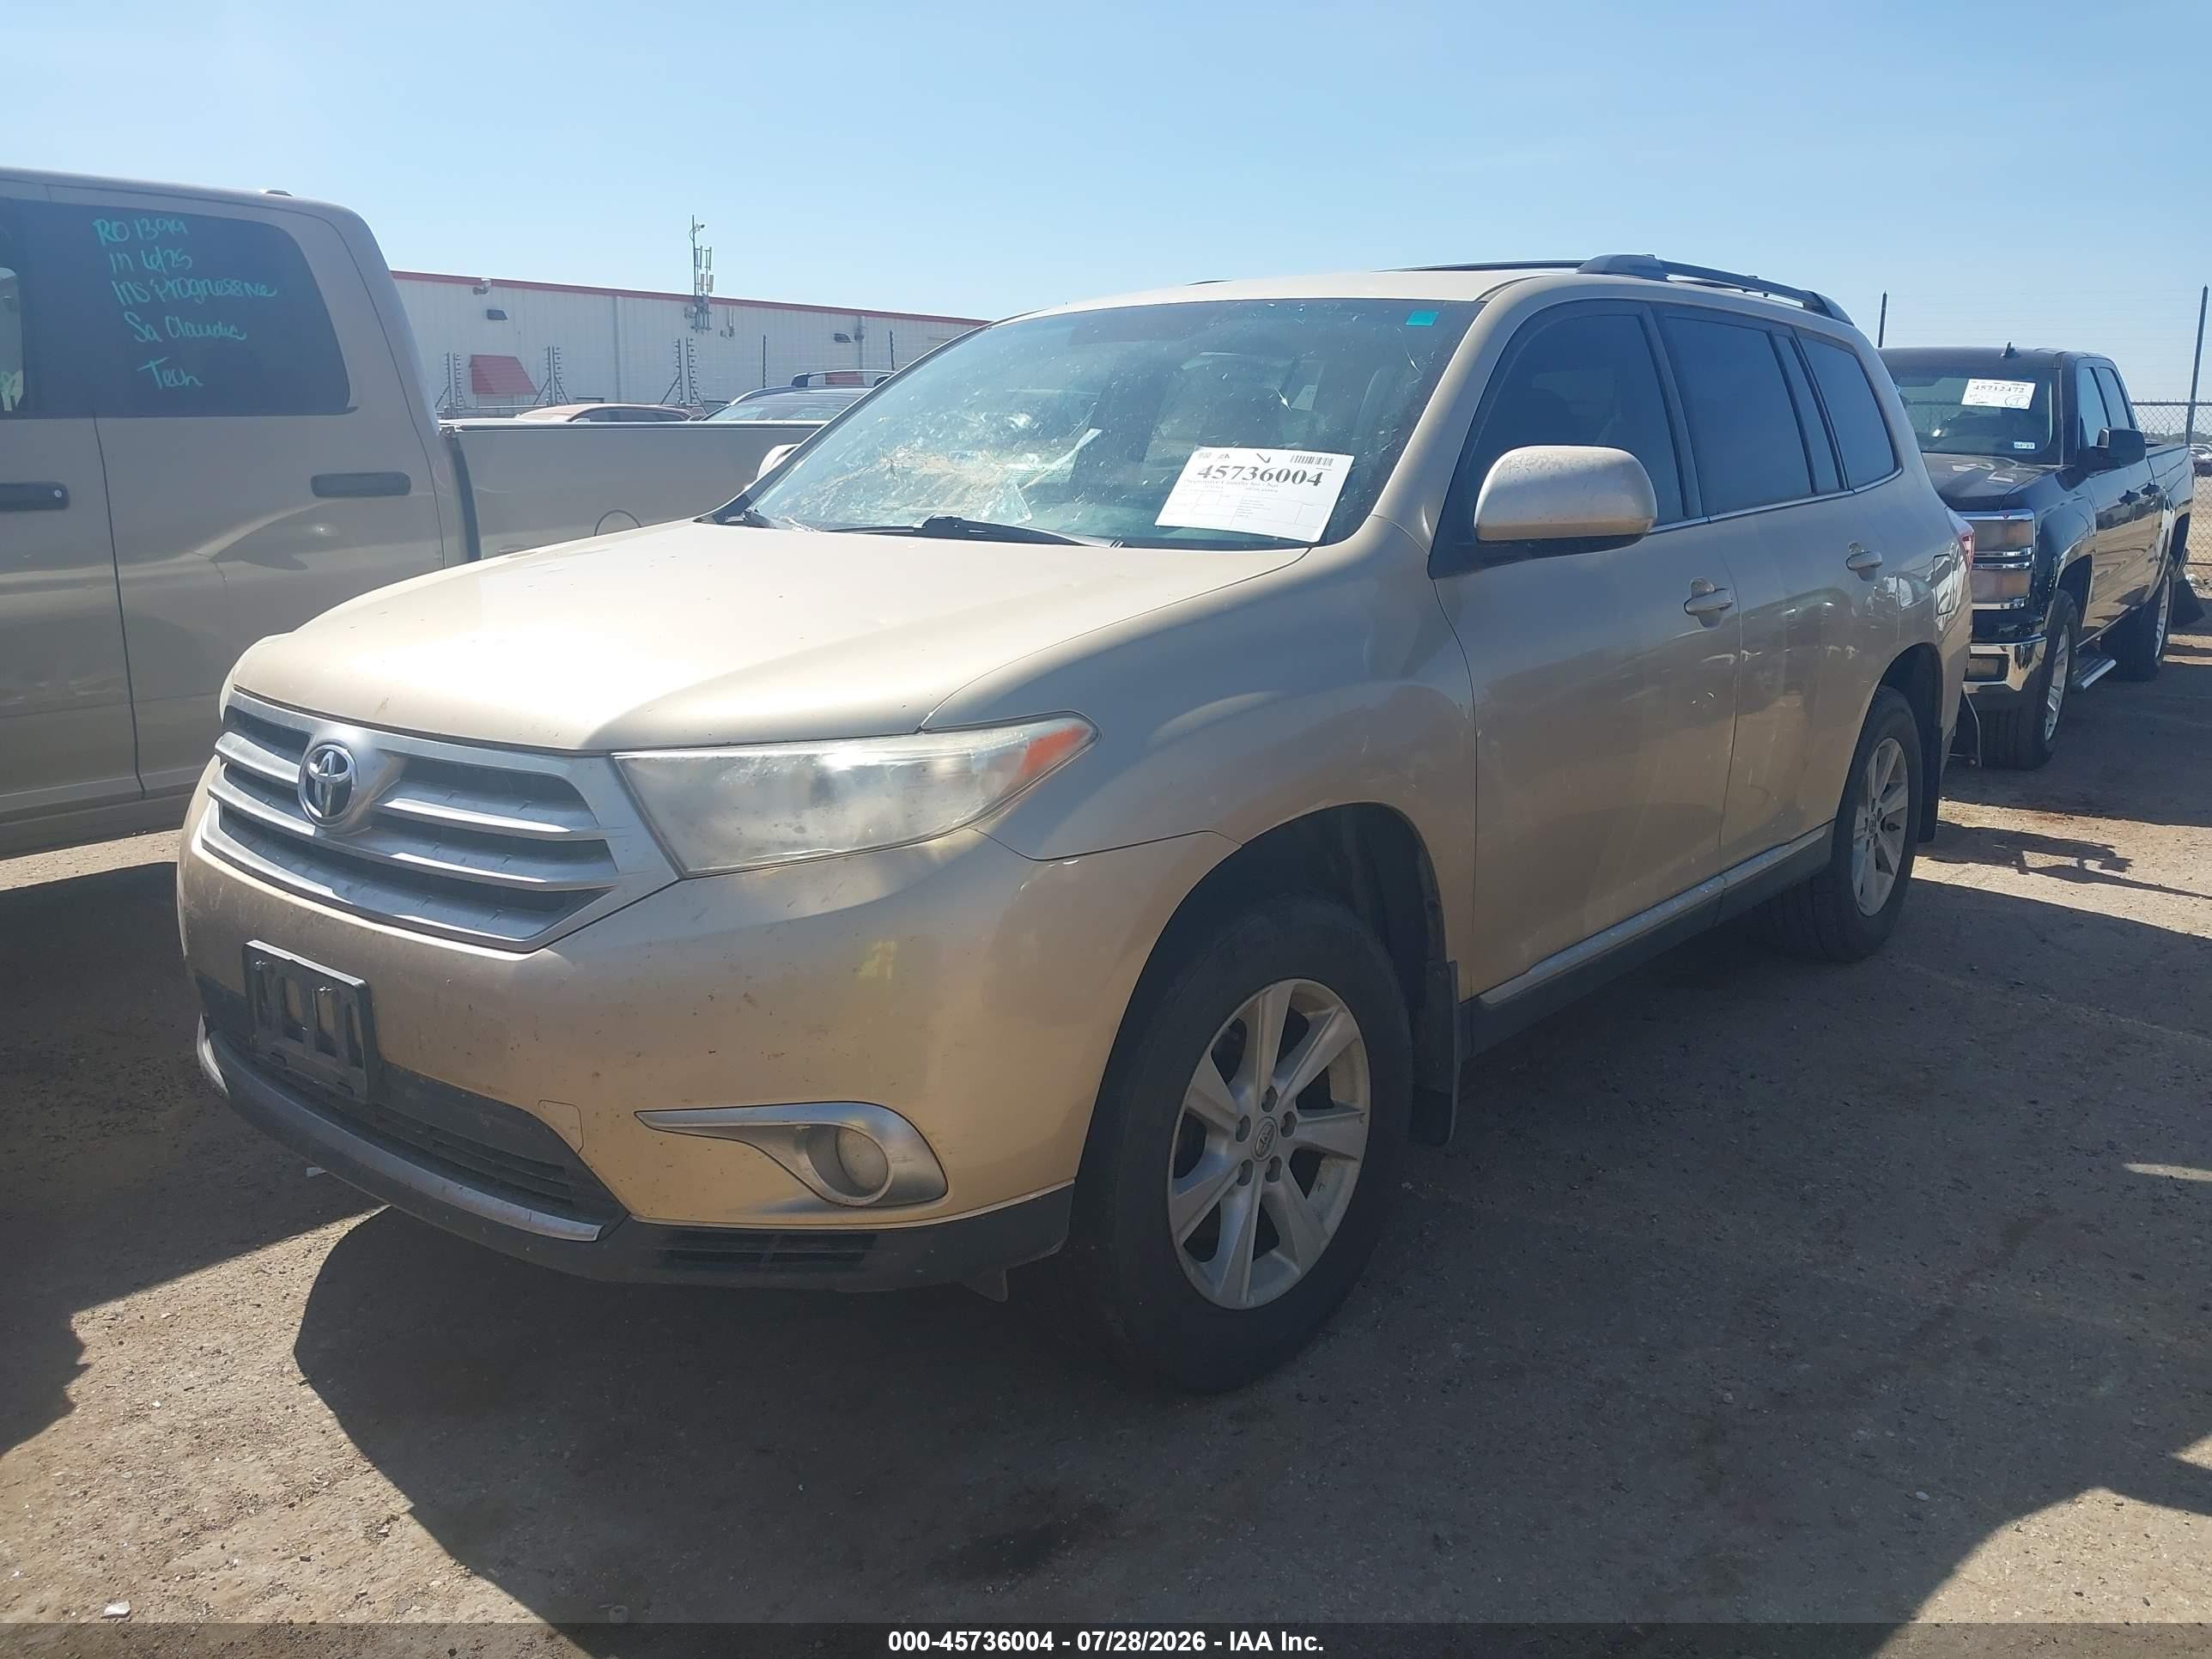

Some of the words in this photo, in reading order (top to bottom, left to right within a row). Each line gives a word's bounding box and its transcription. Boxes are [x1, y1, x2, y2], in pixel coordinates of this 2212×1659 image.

[134, 217, 188, 240] 1399
[137, 356, 204, 389] Tech
[1196, 465, 1324, 487] 45736004
